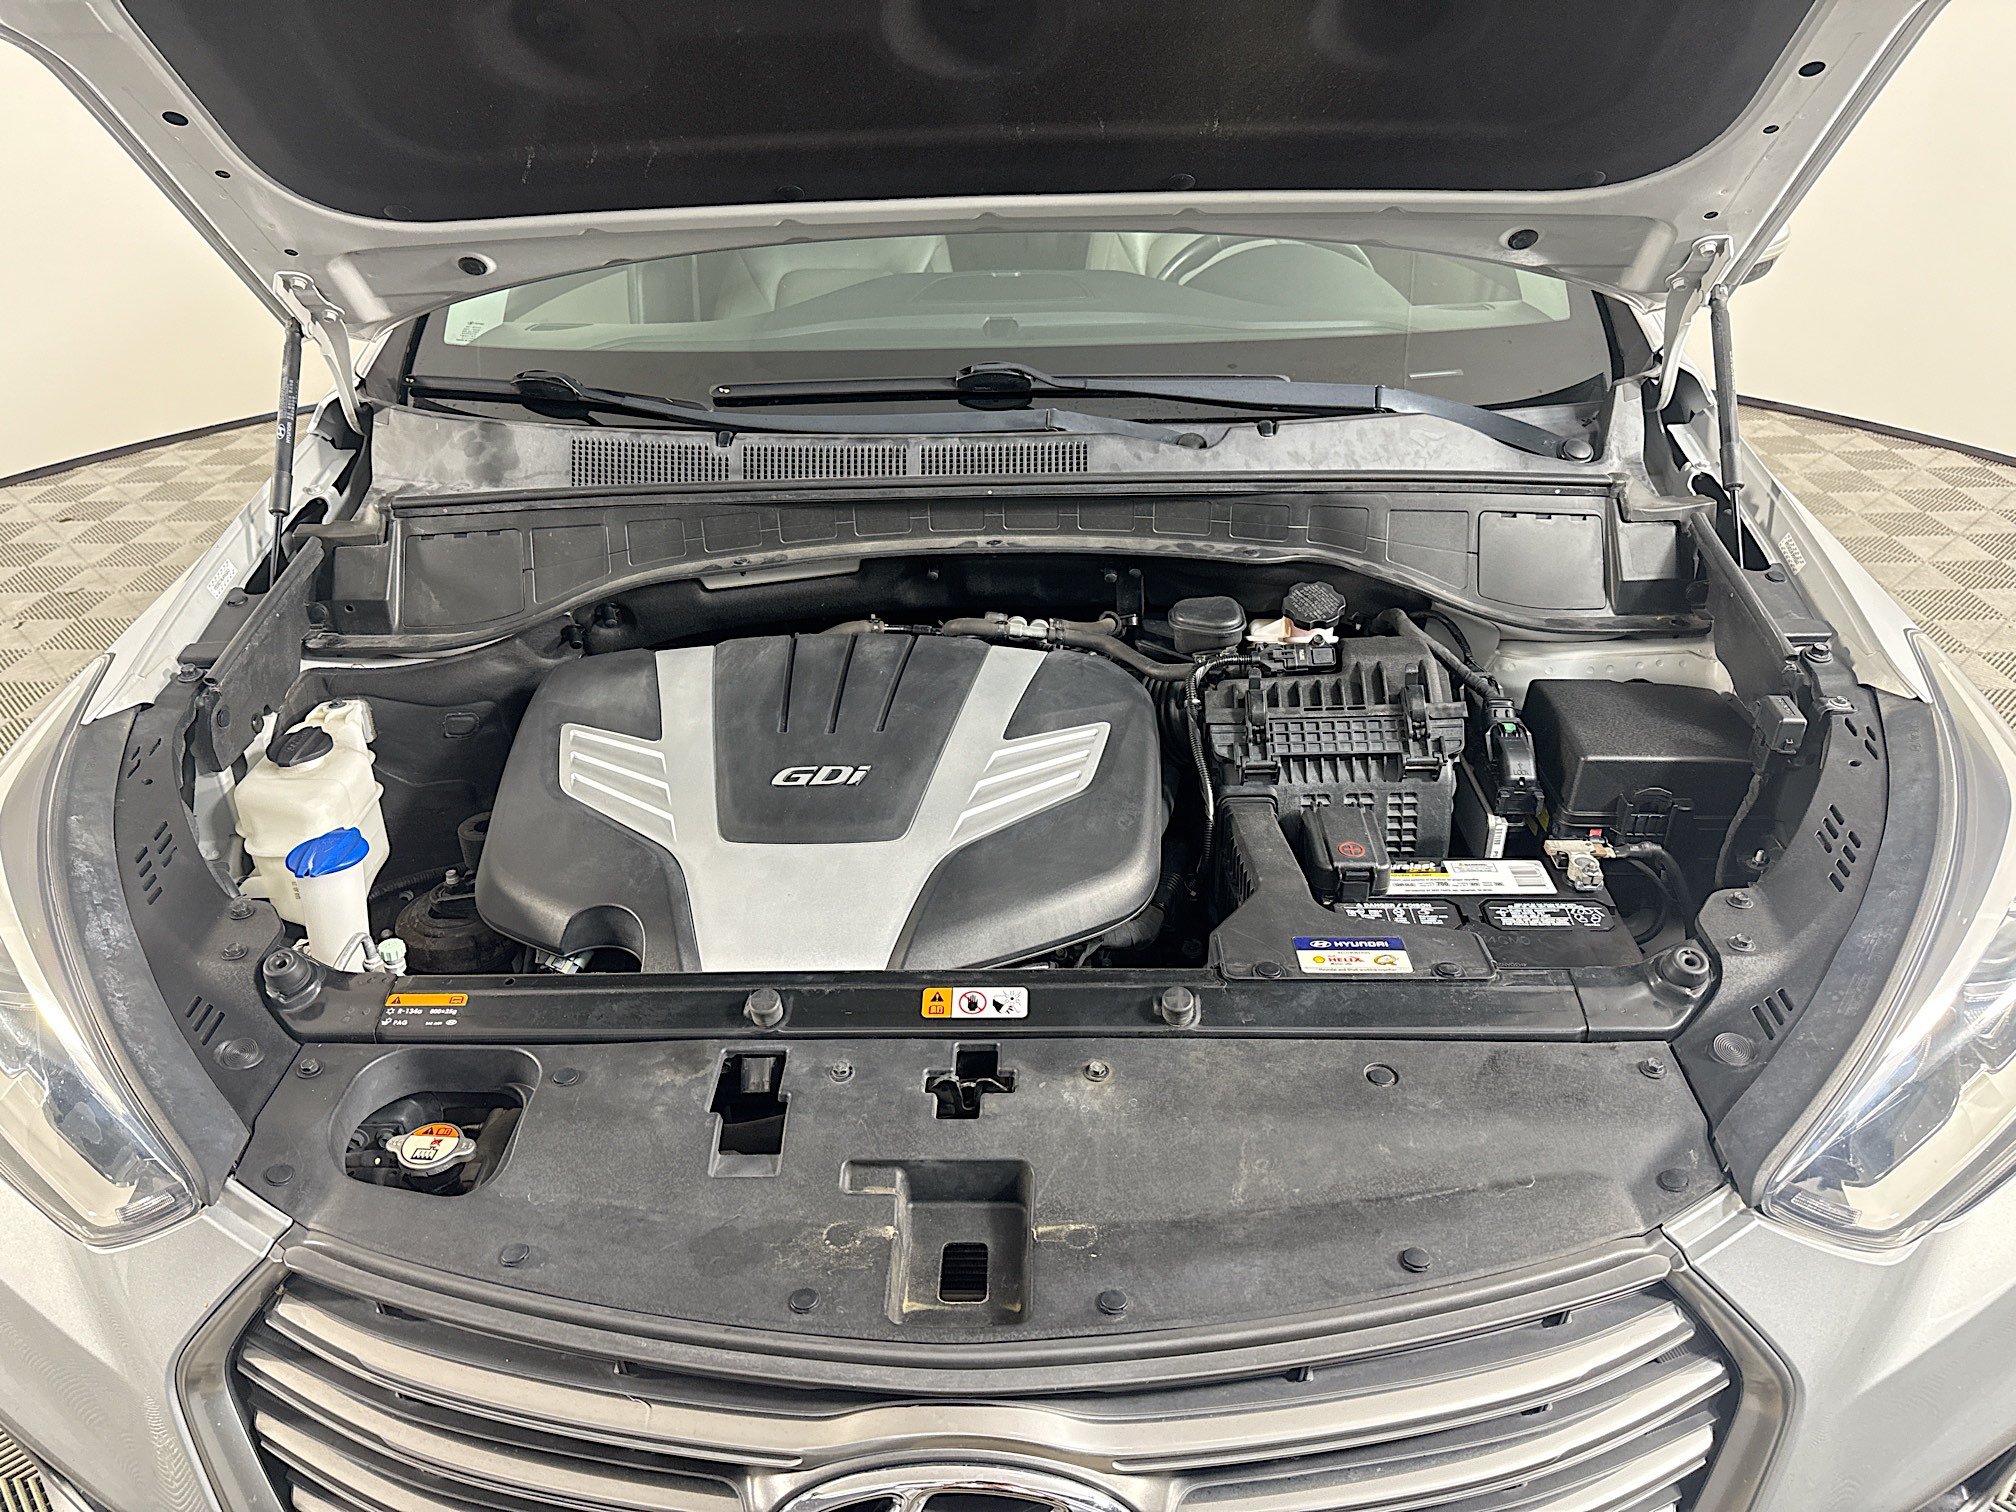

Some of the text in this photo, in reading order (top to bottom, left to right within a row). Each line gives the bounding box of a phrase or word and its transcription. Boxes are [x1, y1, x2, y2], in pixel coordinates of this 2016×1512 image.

[771, 765, 872, 787] GDi
[1391, 862, 1436, 870] uralast
[397, 1007, 423, 1015] R-134a
